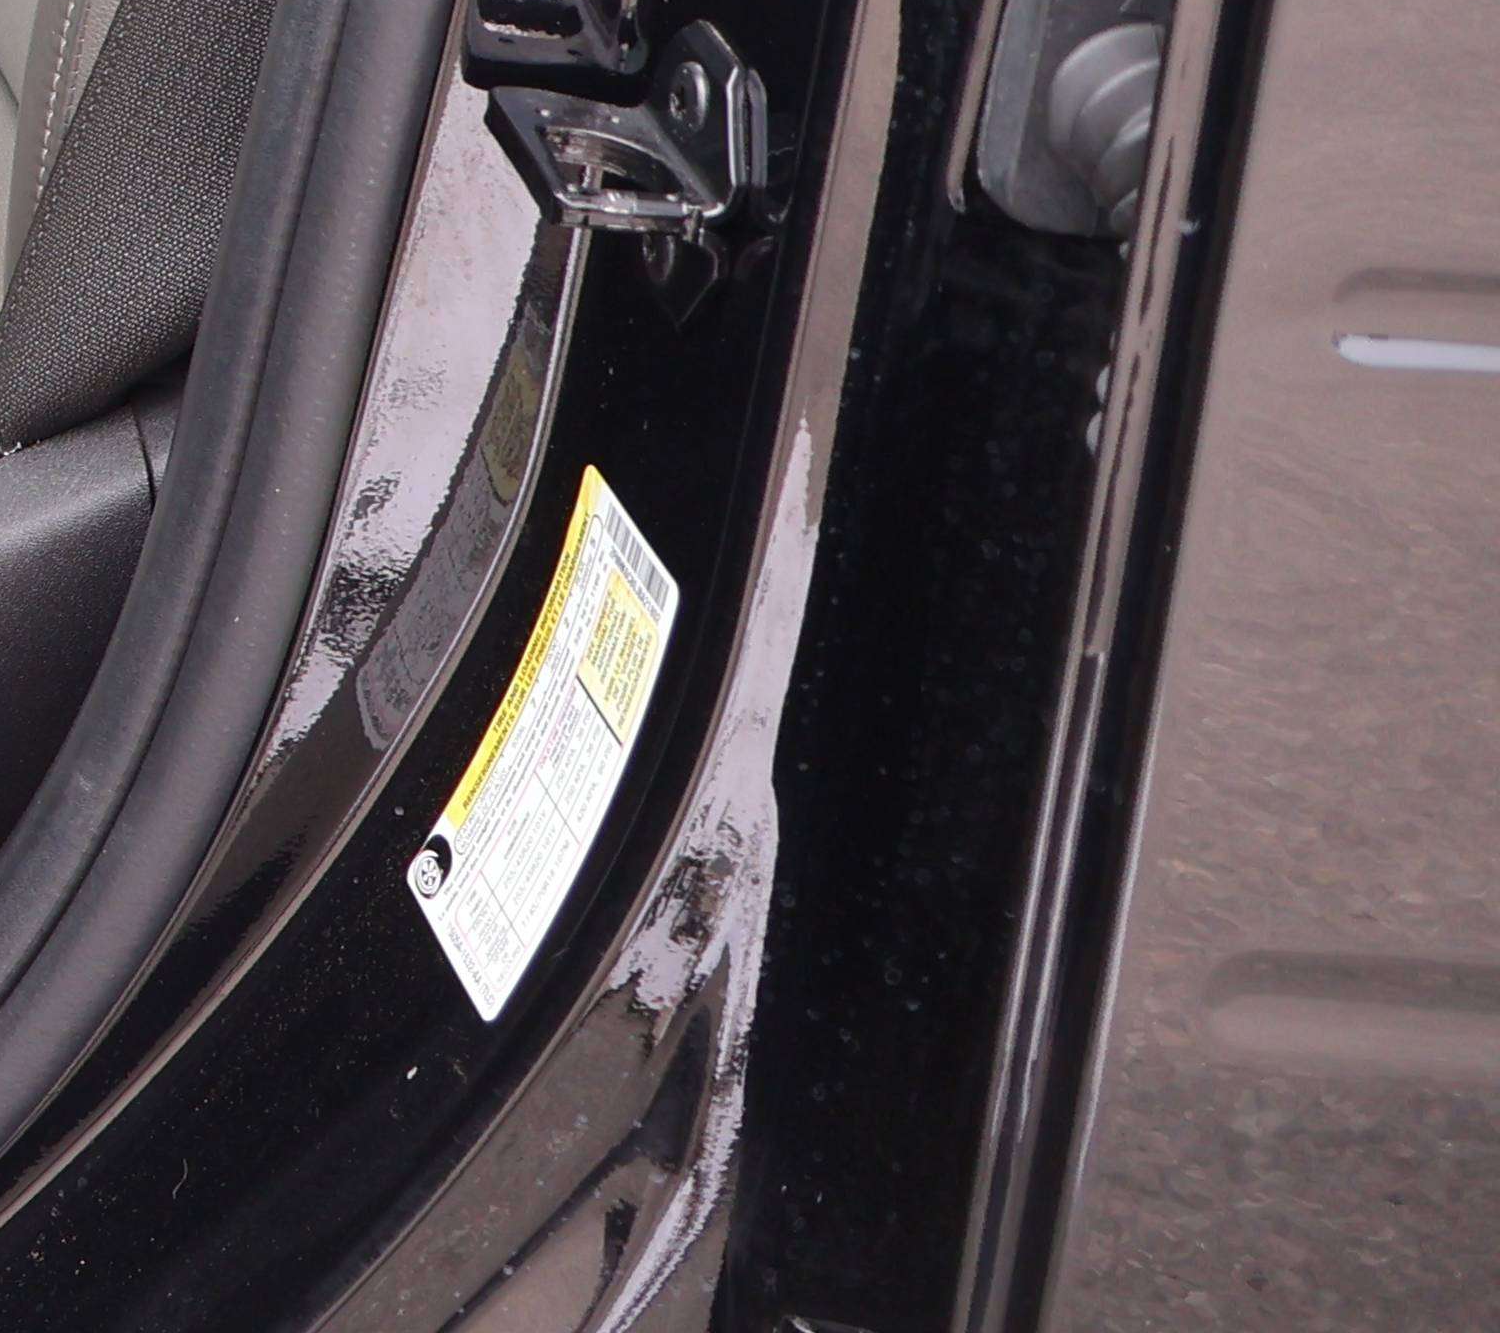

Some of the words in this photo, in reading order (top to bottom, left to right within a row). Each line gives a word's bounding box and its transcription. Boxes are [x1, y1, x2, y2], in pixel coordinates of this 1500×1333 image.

[462, 711, 515, 810] RENSEIGNEMENTS
[513, 685, 526, 713] SUR
[523, 662, 536, 689] LES
[533, 622, 553, 665] PNEUS
[549, 606, 559, 625] ET
[555, 590, 564, 608] LE
[561, 510, 589, 592] CHARGEMENT
[492, 707, 507, 734] TIRE
[505, 678, 520, 708] AND
[518, 628, 541, 680] LOADING
[538, 549, 570, 631] INFORMATION
